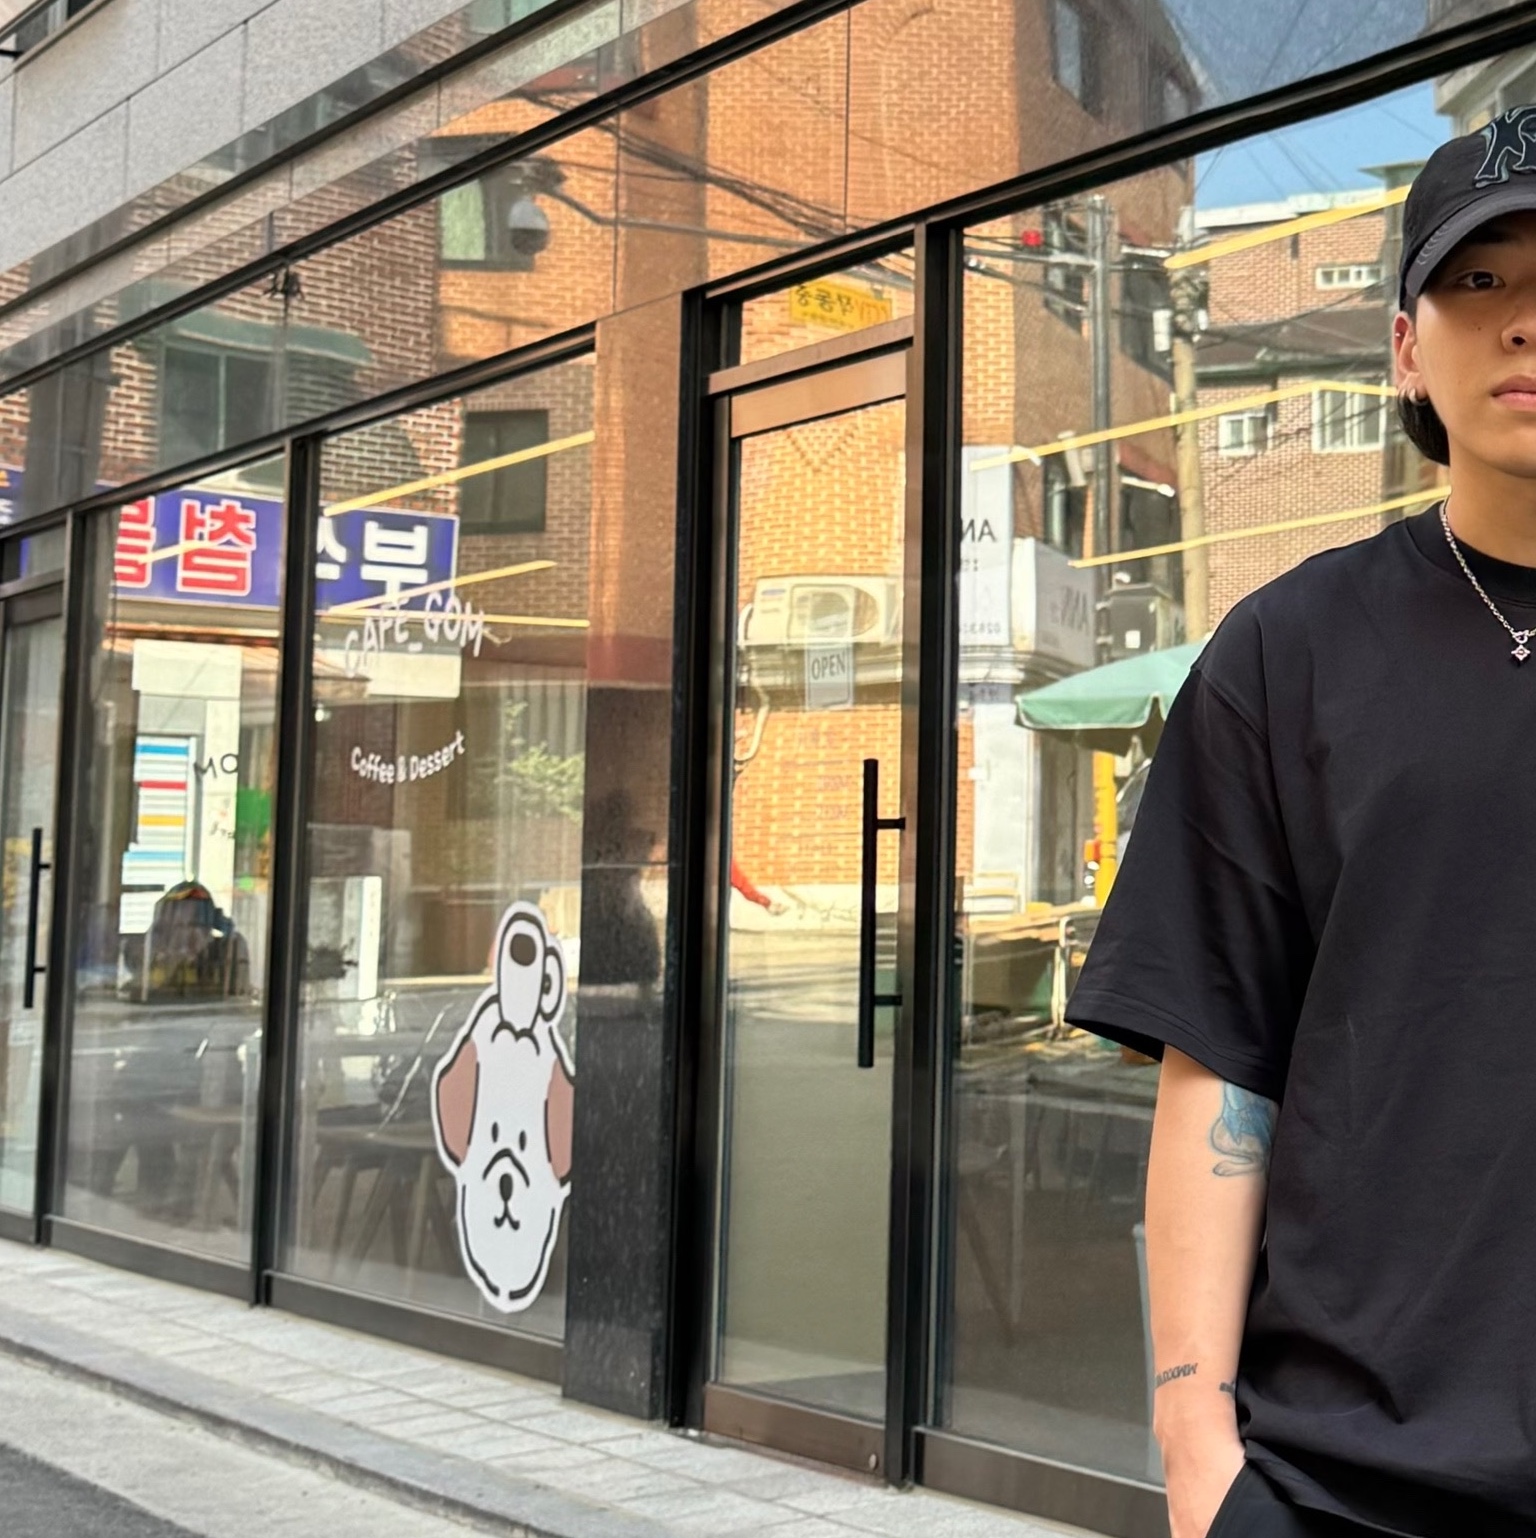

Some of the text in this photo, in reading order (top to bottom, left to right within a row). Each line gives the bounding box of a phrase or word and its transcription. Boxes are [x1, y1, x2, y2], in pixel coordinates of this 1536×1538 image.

[811, 650, 846, 680] OPEN
[351, 746, 395, 784] Coffee
[409, 729, 465, 781] Dessert
